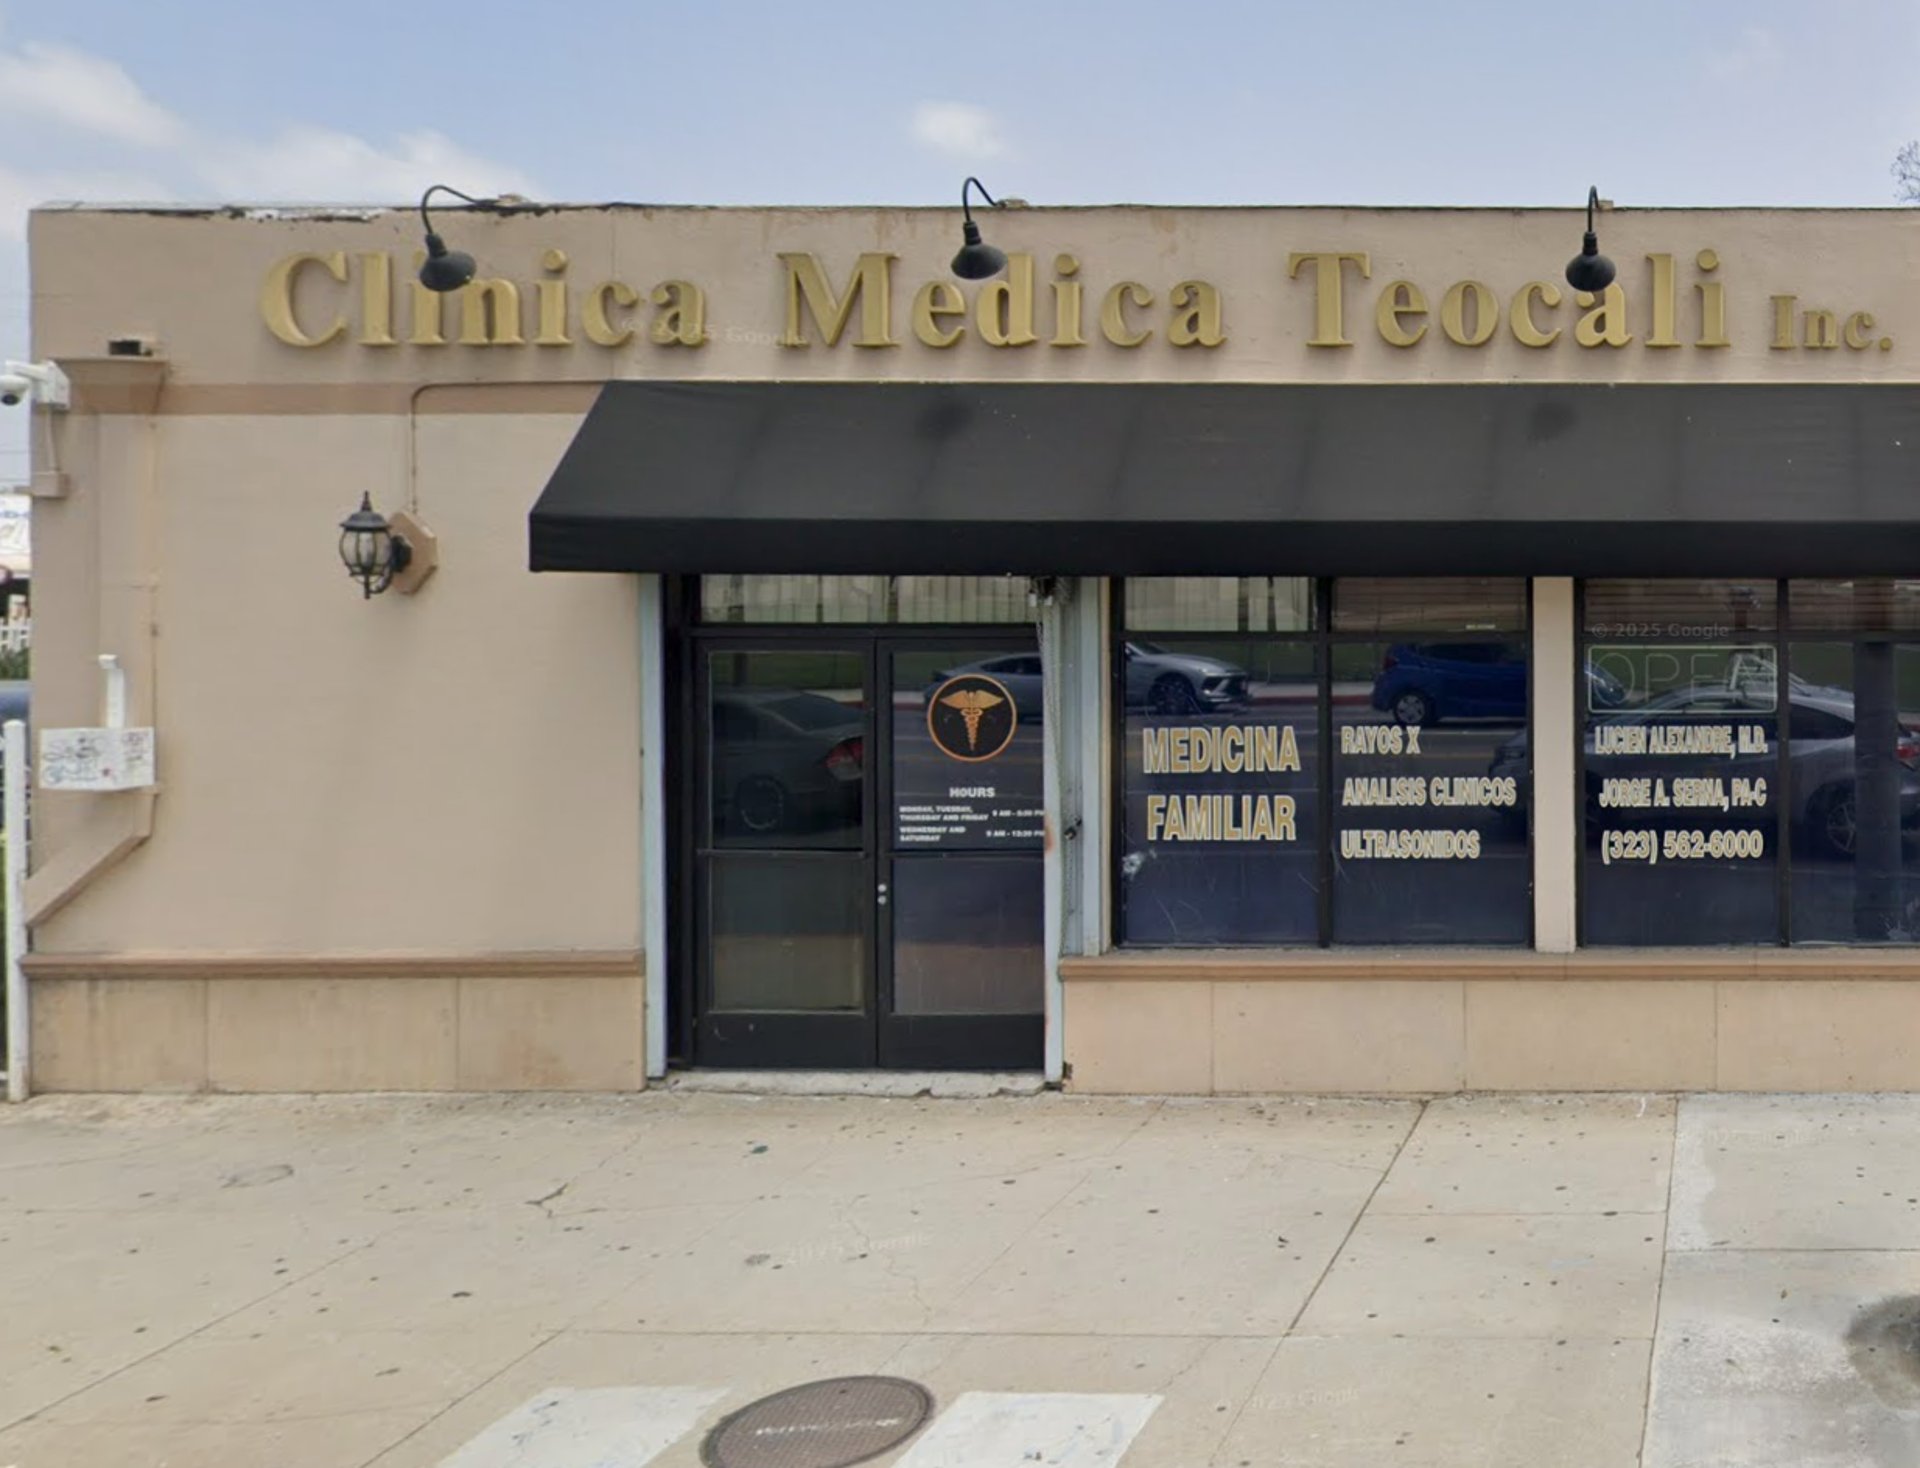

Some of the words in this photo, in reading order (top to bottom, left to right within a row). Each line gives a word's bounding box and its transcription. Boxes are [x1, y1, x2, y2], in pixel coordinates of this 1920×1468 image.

[259, 249, 709, 347] Clinica
[775, 252, 1227, 348] Medica
[1288, 248, 1732, 348] Teocali
[1769, 295, 1894, 350] Inc.
[1142, 726, 1301, 773] MEDICINA
[1340, 725, 1403, 755] RAYOS
[1406, 726, 1421, 754] X
[1594, 725, 1647, 754] LUCIEN
[1649, 725, 1736, 760] ALEXANDRE,
[1738, 725, 1768, 754] M.D.
[949, 787, 996, 798] HOURS
[1342, 777, 1426, 806] ANALISIS
[1430, 777, 1517, 806] CLINICOS
[1599, 778, 1651, 808] JORGE
[1654, 778, 1670, 807] A.
[1672, 778, 1729, 812] SERNA,
[1731, 778, 1767, 807] PA-C
[1146, 795, 1297, 841] FAMILIAR
[1340, 830, 1481, 859] ULTRASONIDOS
[1601, 830, 1658, 865] (323)
[1663, 830, 1764, 859] 562-6000
